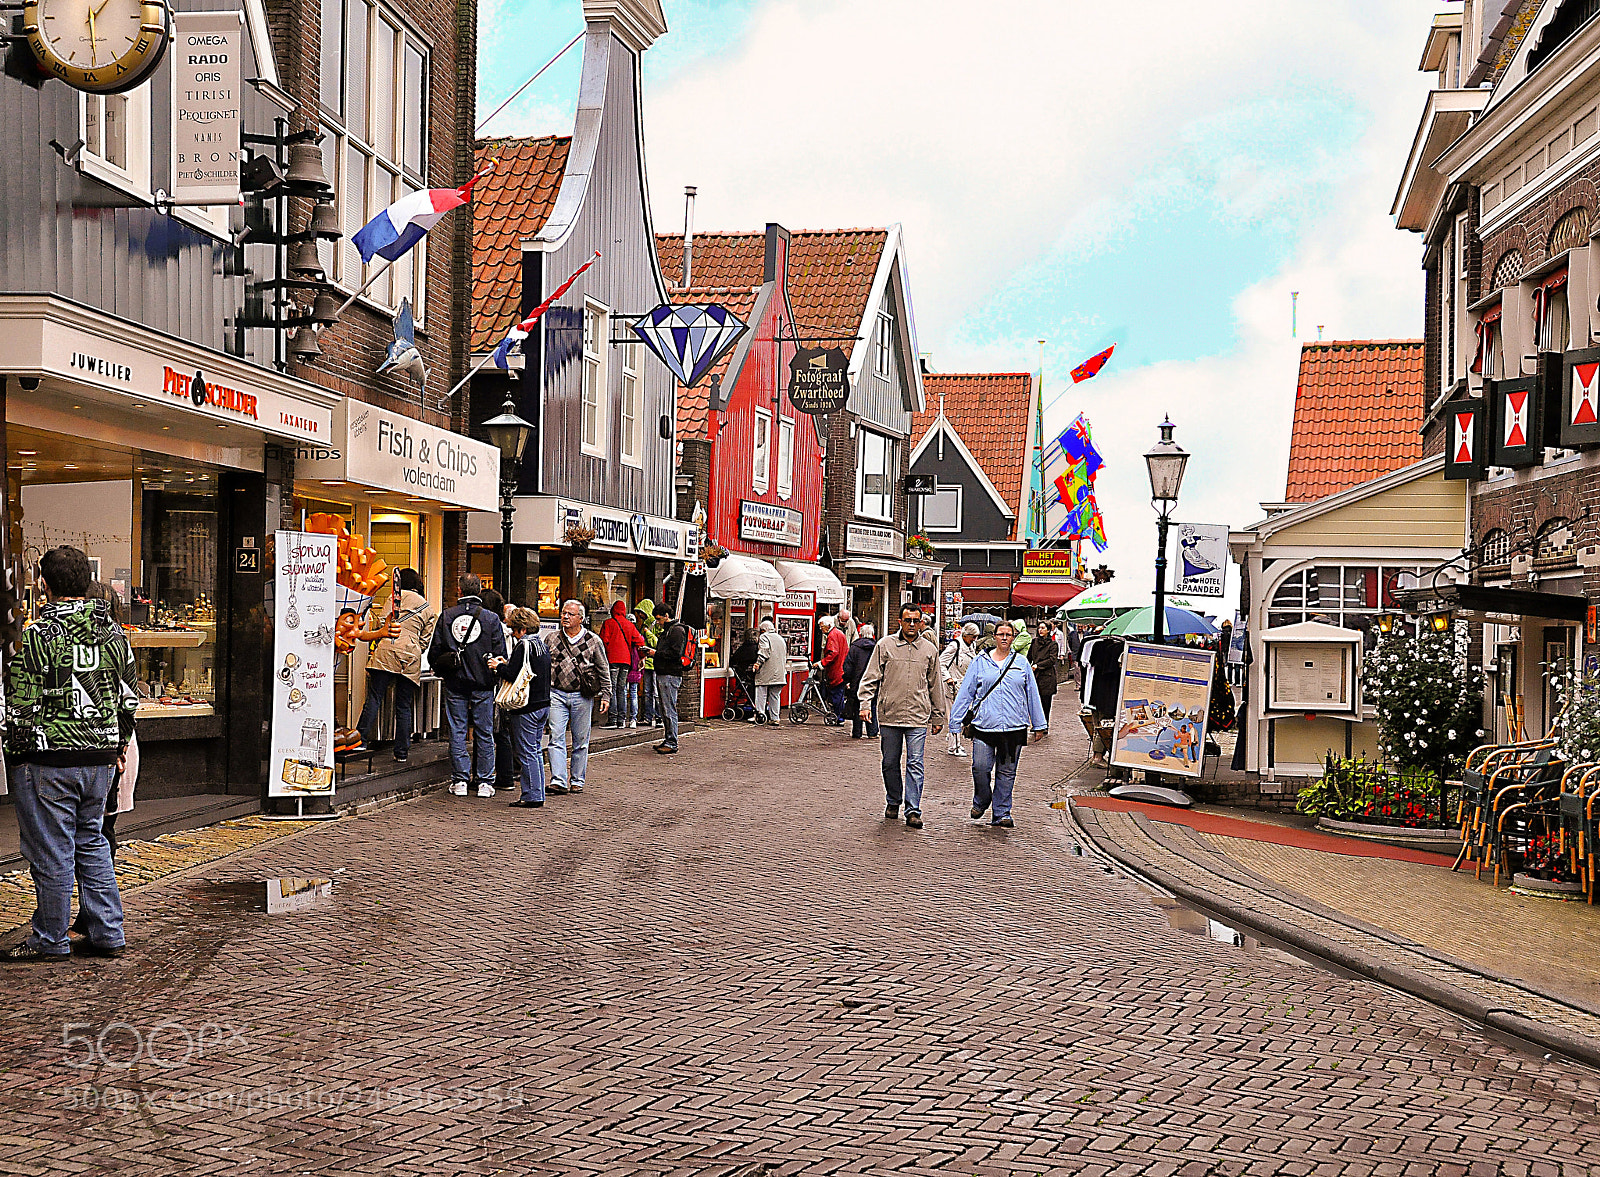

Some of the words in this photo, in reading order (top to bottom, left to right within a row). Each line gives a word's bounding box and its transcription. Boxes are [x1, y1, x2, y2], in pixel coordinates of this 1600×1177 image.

[187, 35, 229, 46] OMEGA
[188, 54, 229, 65] RADO
[83, 72, 99, 82] VI
[195, 72, 221, 82] ORIS
[184, 89, 231, 101] TIRISI
[178, 171, 193, 179] PIET
[204, 170, 238, 178] SCHILDER
[70, 352, 131, 381] JUWELIER
[795, 368, 843, 386] Fotograaf
[163, 366, 192, 399] PIET
[204, 382, 258, 420] SCHILDER
[793, 385, 844, 399] Zwarthoed
[279, 411, 319, 433] TAXATEUR
[296, 447, 341, 461] hips
[378, 419, 412, 459] Fish
[418, 438, 431, 464] &
[436, 439, 478, 477] Chips
[402, 466, 456, 493] volendam
[240, 553, 256, 568] 24
[1026, 559, 1067, 567] EINDPUNT
[1199, 577, 1221, 585] HOTEL
[1176, 583, 1220, 594] SPAANDER
[785, 593, 803, 601] OTOS
